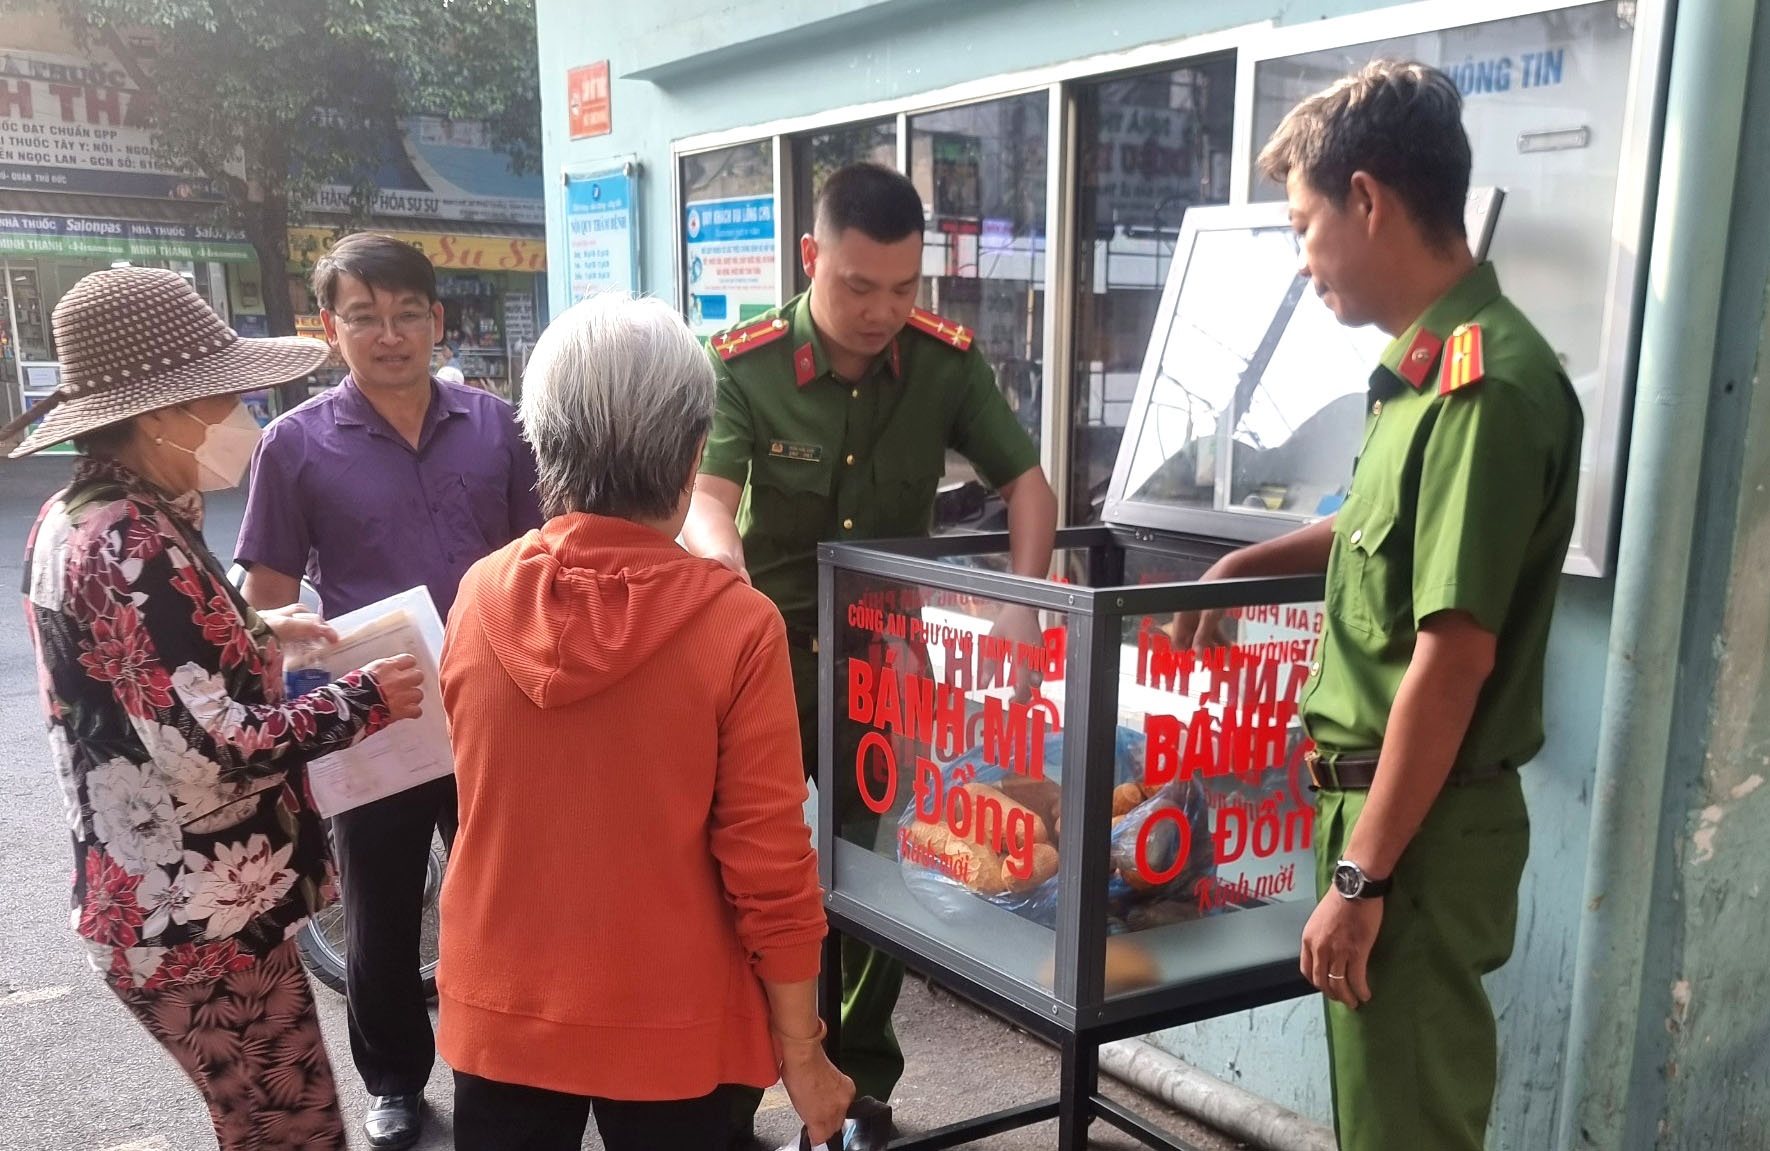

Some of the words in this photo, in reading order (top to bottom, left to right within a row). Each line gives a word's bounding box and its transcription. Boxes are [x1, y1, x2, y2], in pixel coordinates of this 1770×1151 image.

[1521, 48, 1563, 88] TIN
[54, 138, 74, 150] TÂY
[94, 129, 118, 139] GPP
[55, 155, 77, 165] LAN
[407, 197, 421, 212] SU
[424, 199, 439, 214] SU
[66, 218, 122, 234] Salonpas
[848, 600, 884, 634] CÔNG
[886, 612, 907, 639] AN
[910, 617, 974, 651] PHƯỜNG
[848, 650, 966, 755] BÁNH
[983, 687, 1046, 781] MÌ
[1144, 691, 1288, 787] BÁNH
[913, 756, 1035, 881] Đồng
[1255, 862, 1296, 899] mời
